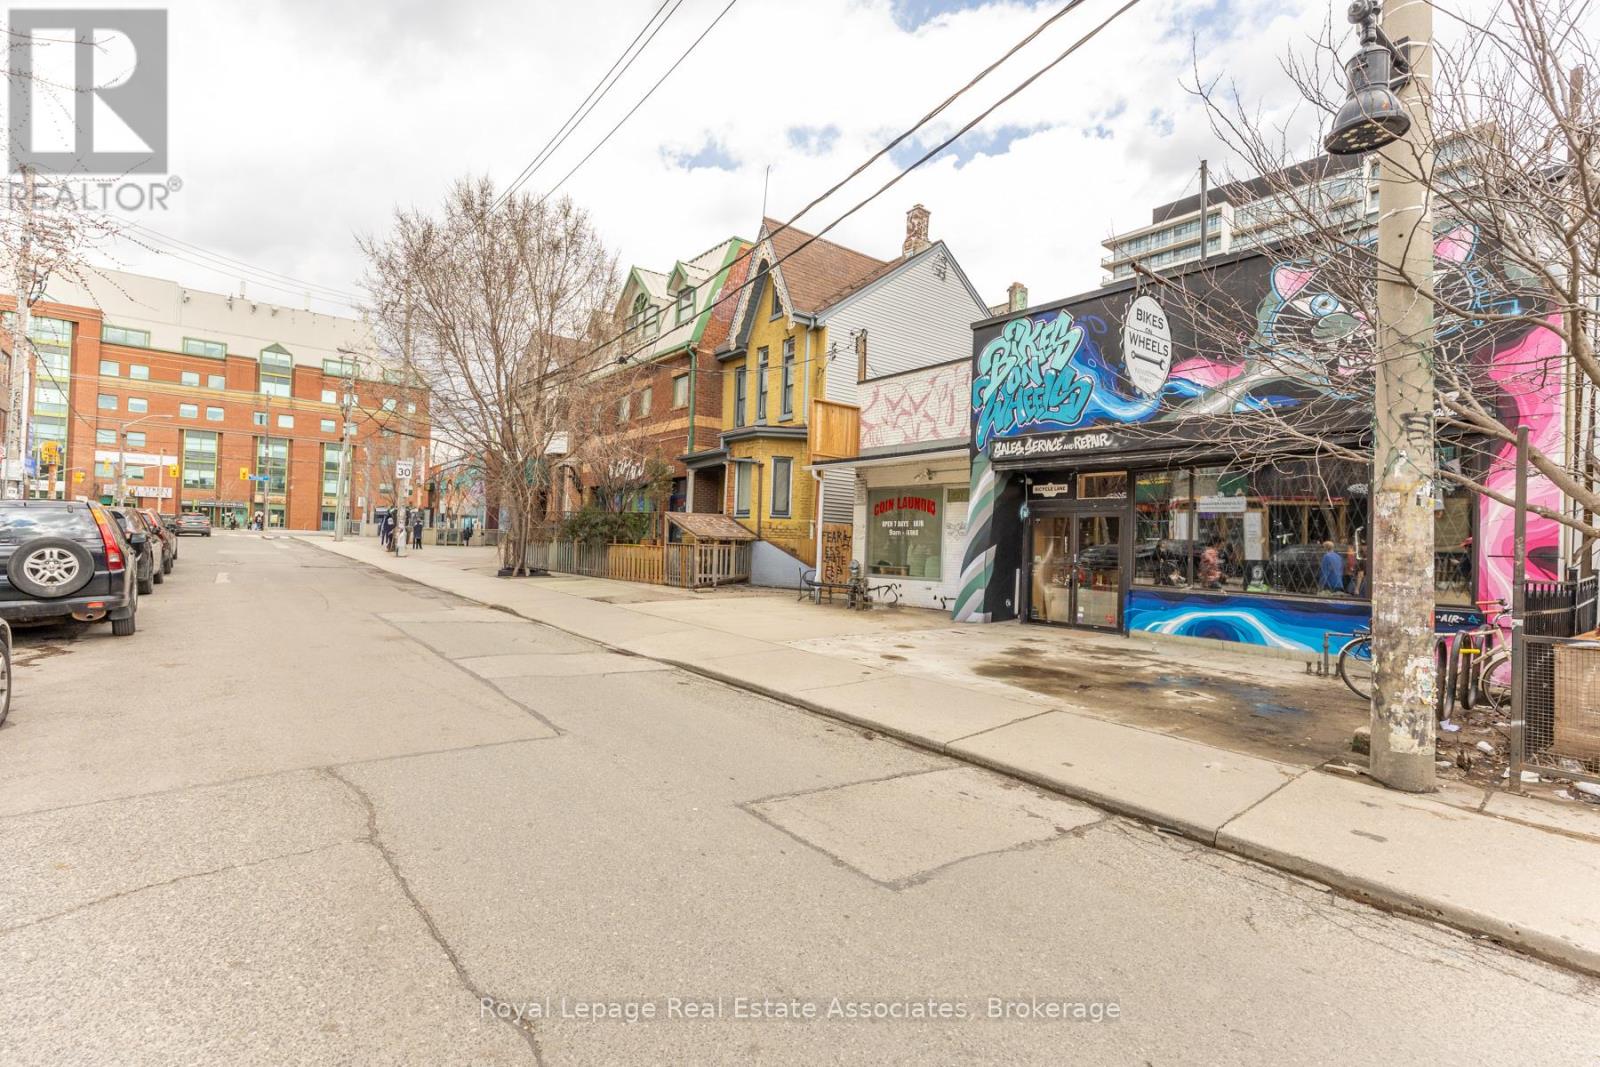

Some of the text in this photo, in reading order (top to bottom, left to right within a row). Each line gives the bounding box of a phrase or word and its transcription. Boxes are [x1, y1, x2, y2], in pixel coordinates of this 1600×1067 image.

[1136, 308, 1164, 329] BIKES
[1129, 331, 1169, 356] WHEELS
[1024, 436, 1066, 455] SERVICE
[1074, 433, 1112, 449] REPAIR
[398, 468, 411, 476] 30
